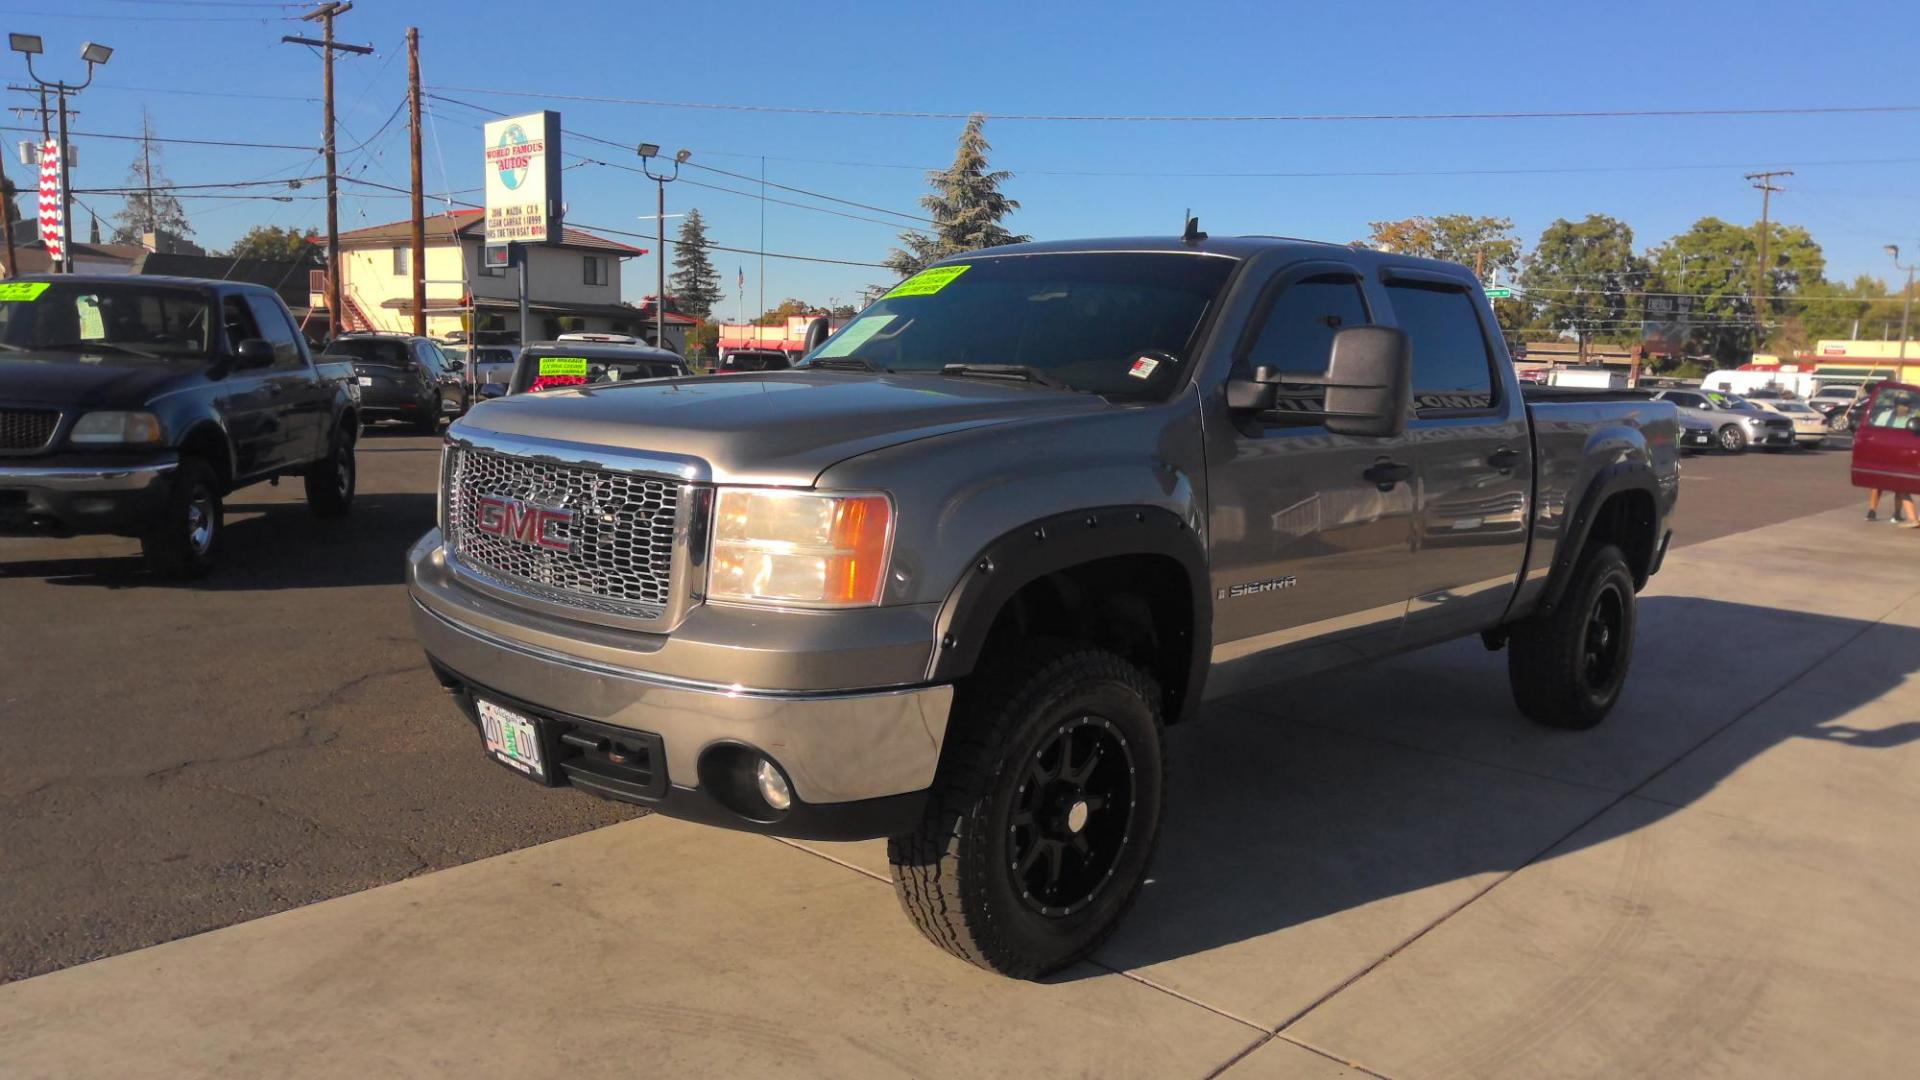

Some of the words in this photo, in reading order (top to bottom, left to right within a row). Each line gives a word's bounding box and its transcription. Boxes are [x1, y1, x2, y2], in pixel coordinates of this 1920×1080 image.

[487, 148, 510, 159] WORLD
[512, 143, 543, 153] FAMOUS
[479, 494, 577, 553] GMC
[1229, 576, 1297, 598] SIERRA
[480, 712, 506, 750] 201
